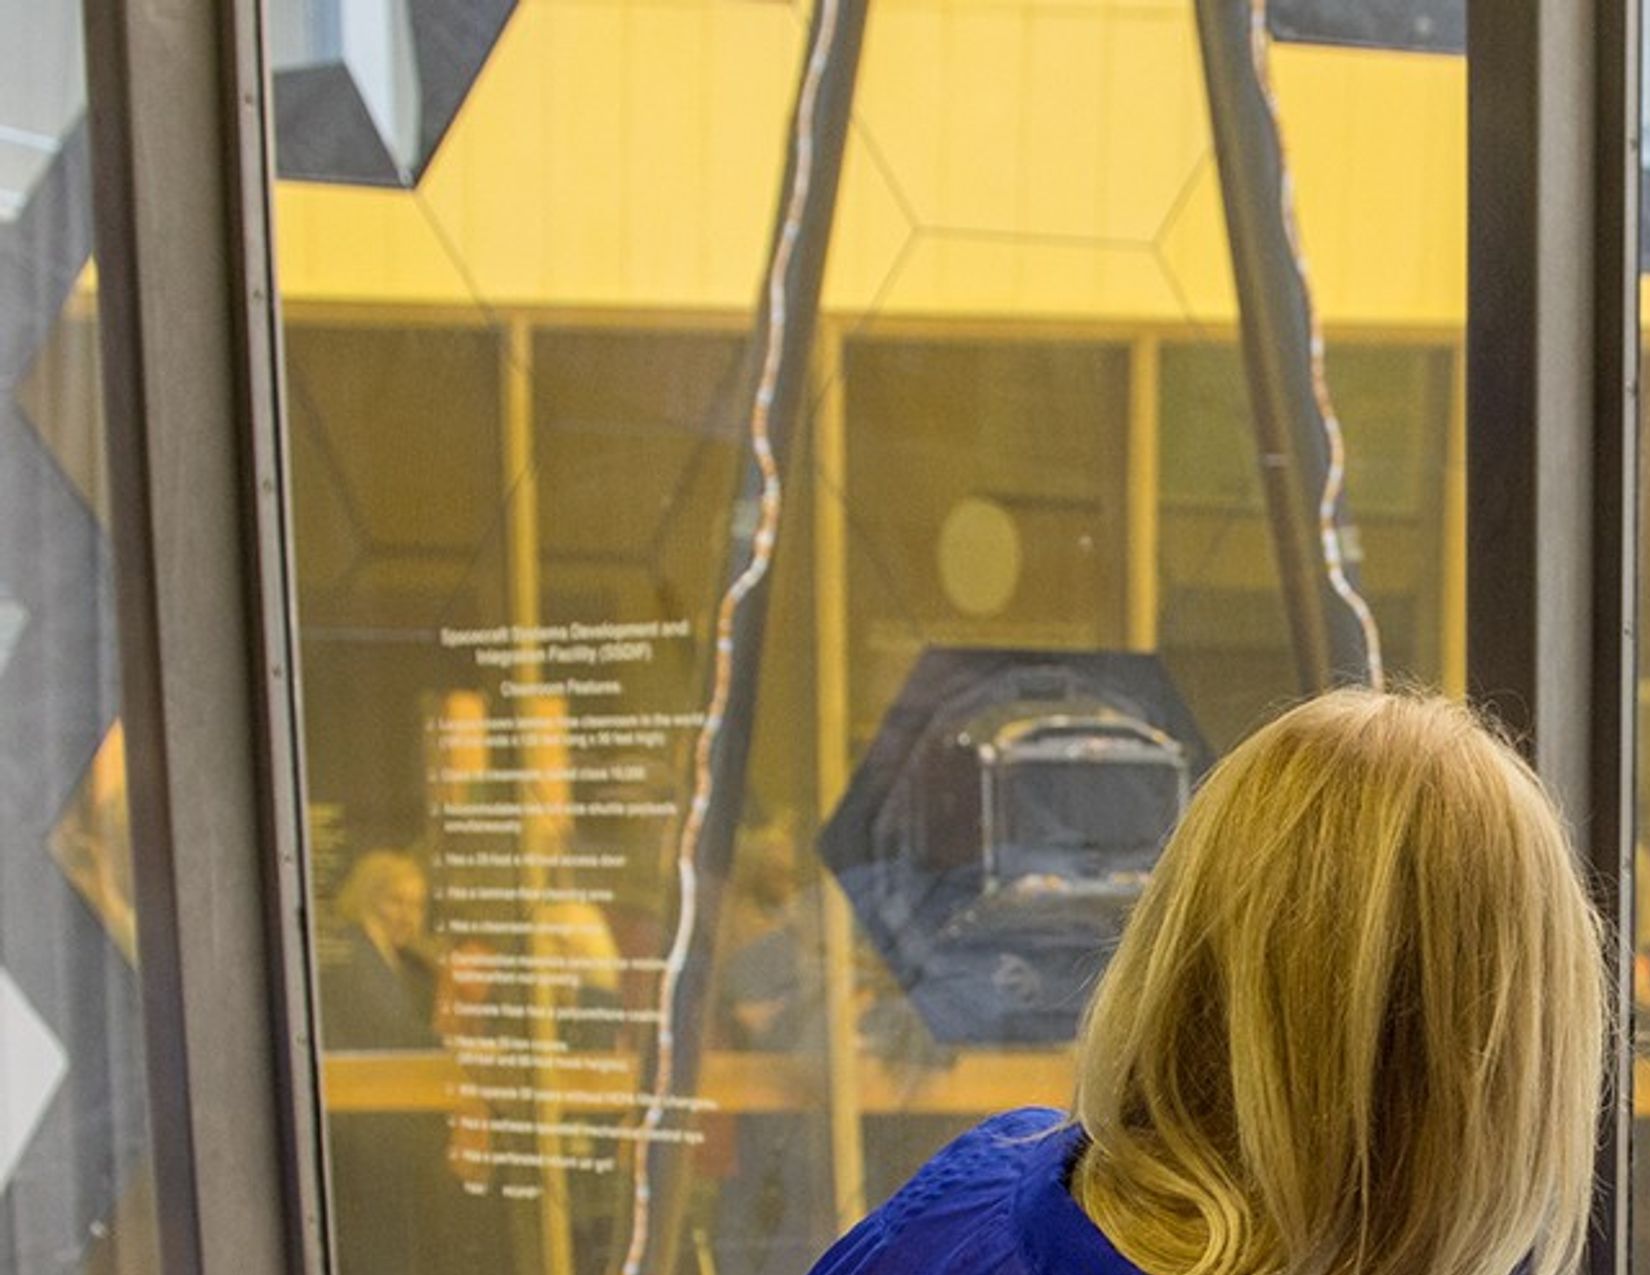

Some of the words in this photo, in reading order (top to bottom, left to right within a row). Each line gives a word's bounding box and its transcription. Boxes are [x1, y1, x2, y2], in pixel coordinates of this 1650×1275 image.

[570, 621, 658, 640] Development
[661, 620, 689, 636] and
[549, 646, 596, 665] Facility
